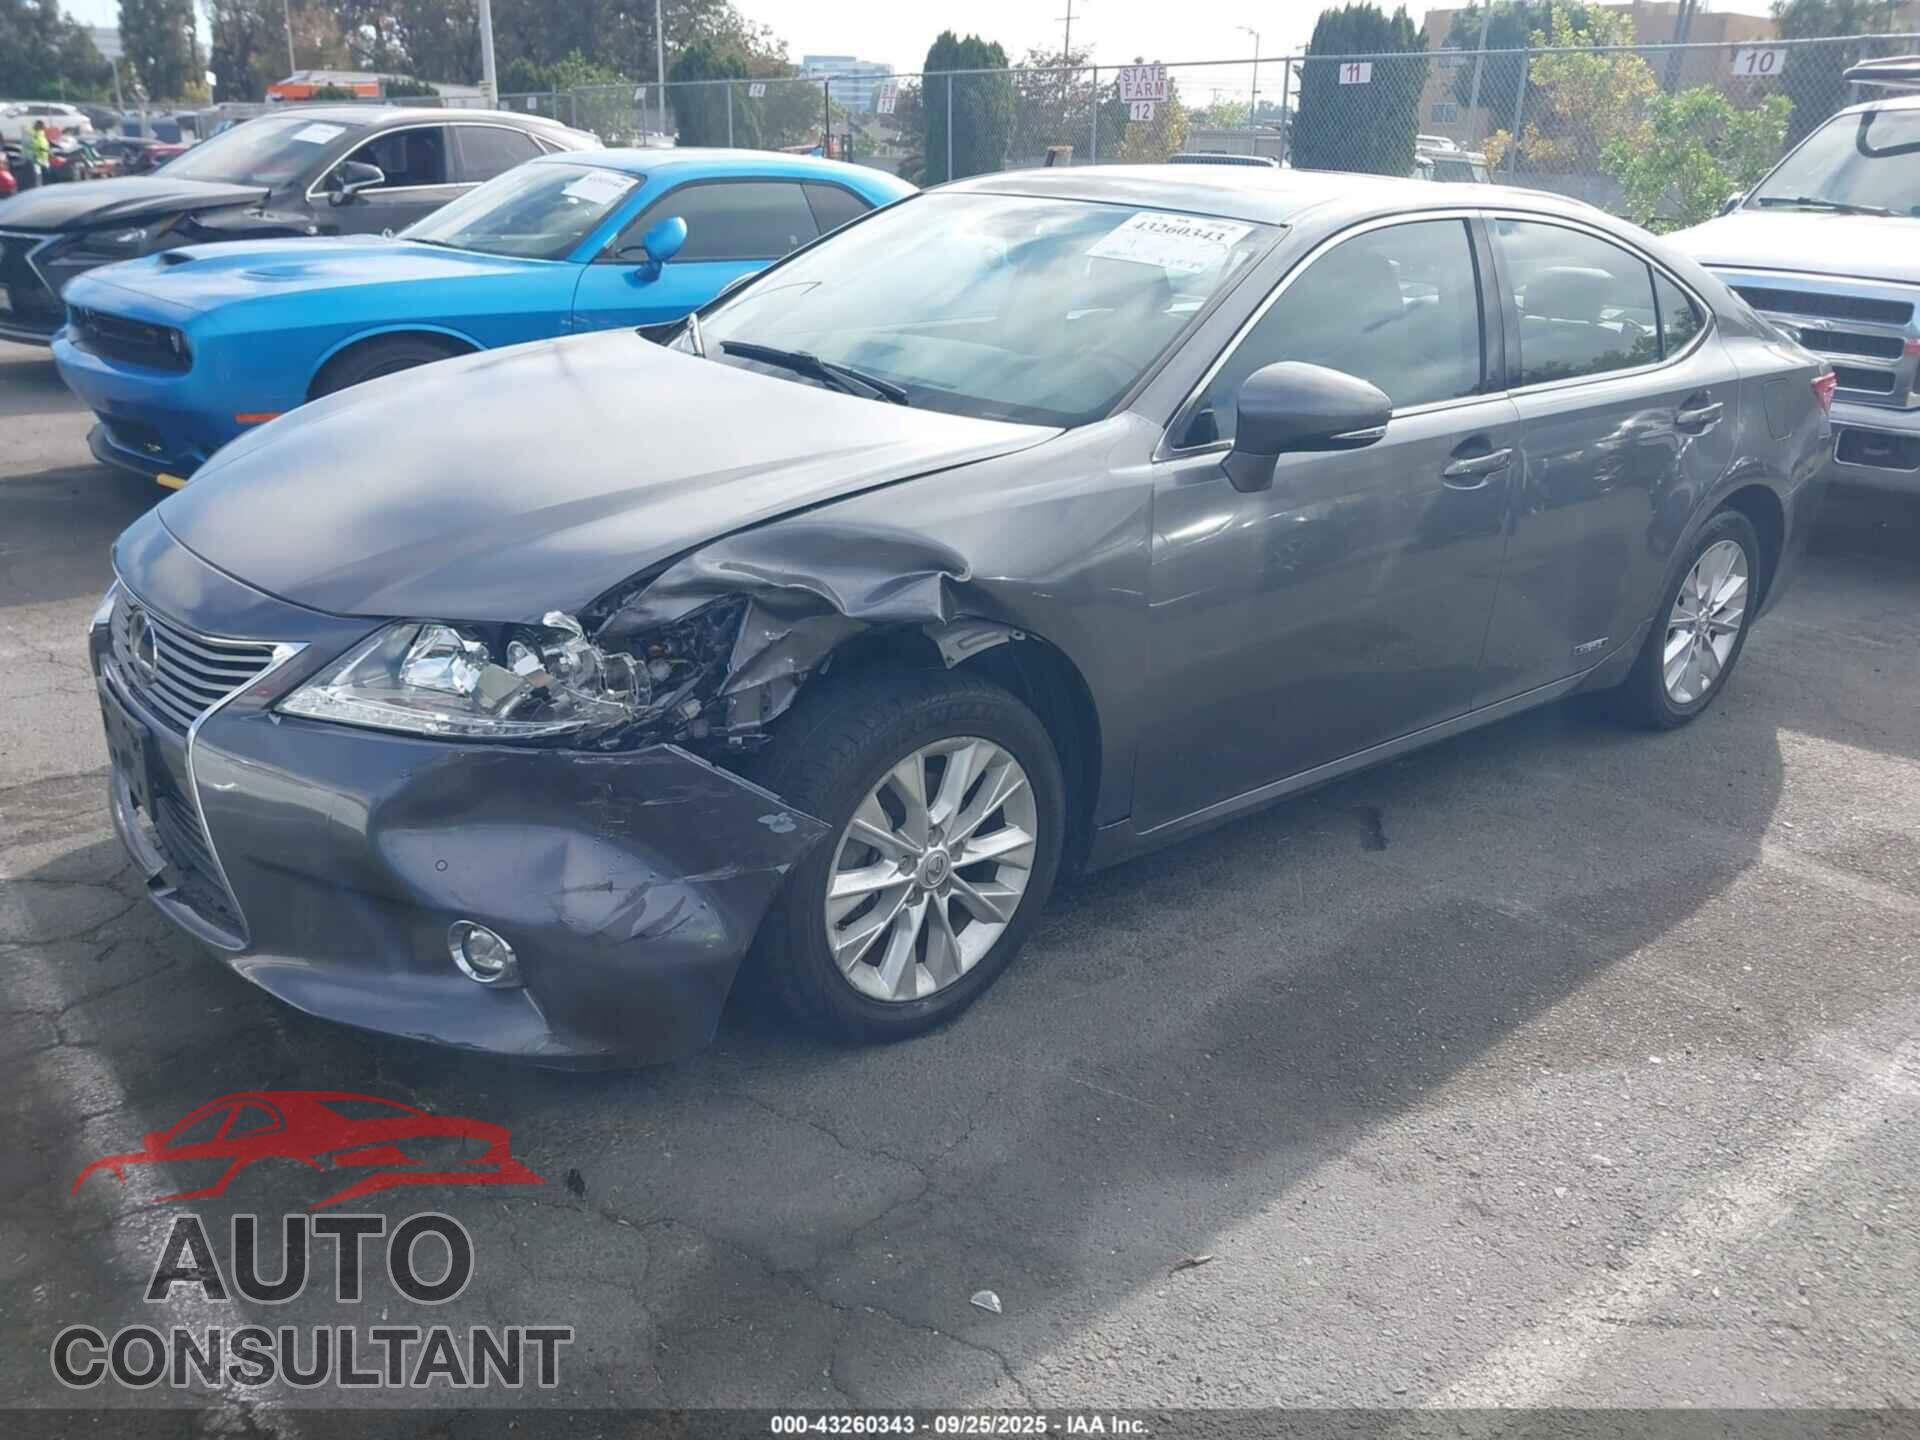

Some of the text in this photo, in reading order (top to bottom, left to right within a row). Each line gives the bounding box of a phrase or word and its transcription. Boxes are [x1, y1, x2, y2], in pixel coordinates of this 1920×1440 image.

[1746, 51, 1775, 73] 10
[1122, 68, 1166, 82] STATE
[1346, 63, 1360, 81] 11
[1125, 82, 1164, 97] FARM
[1135, 103, 1150, 120] 12
